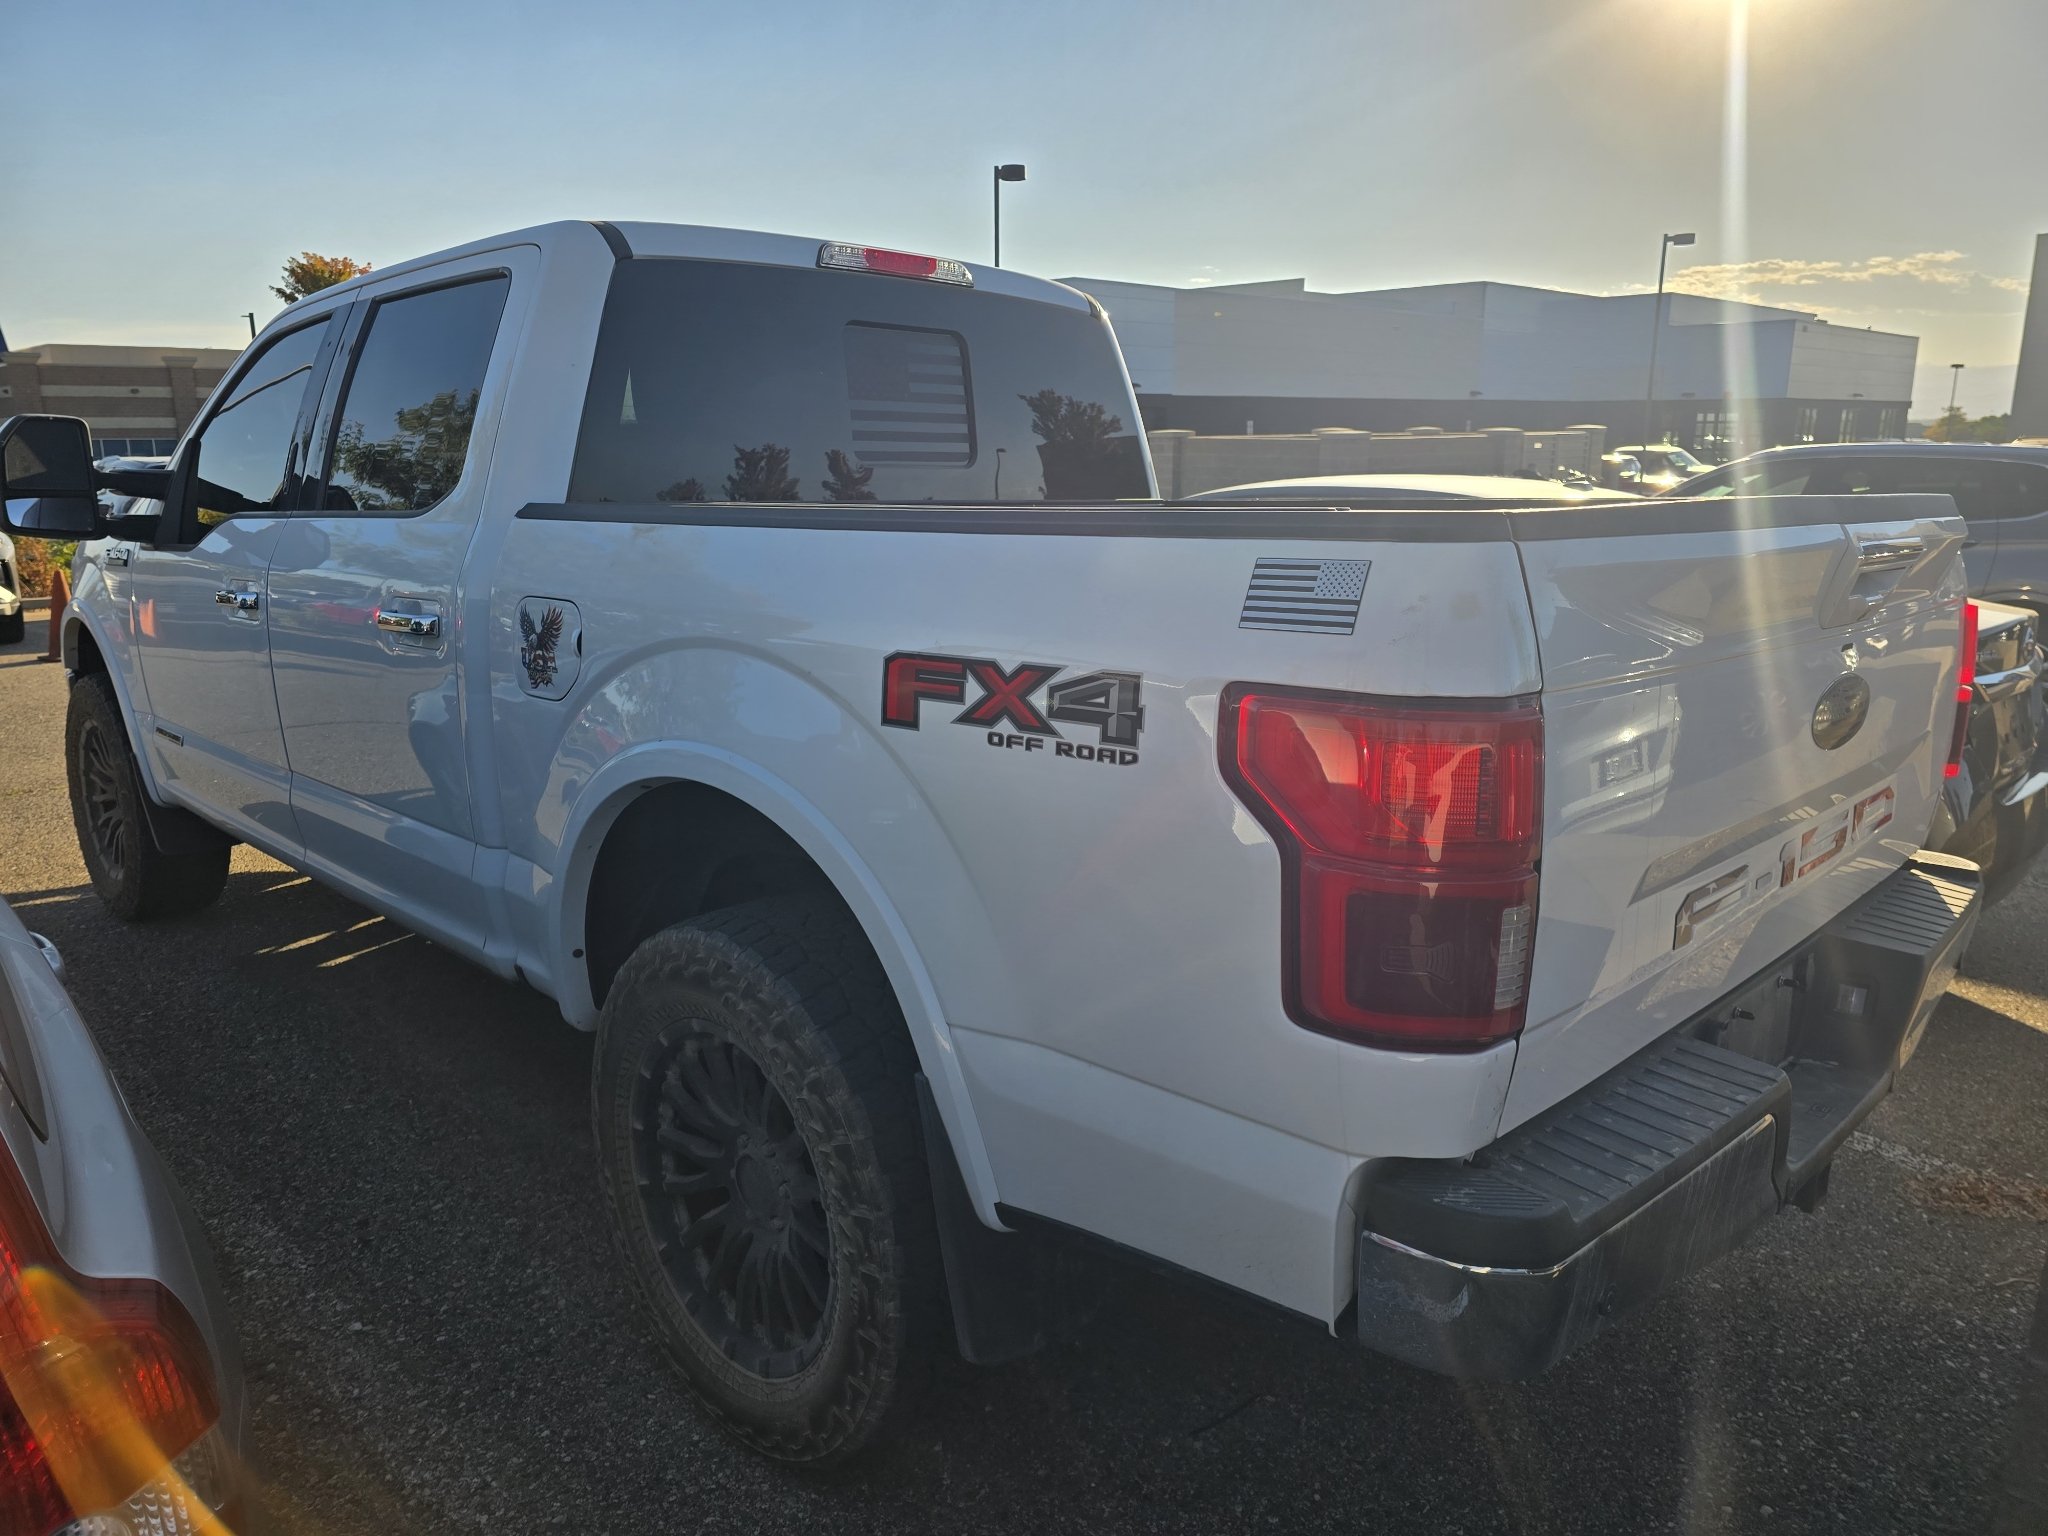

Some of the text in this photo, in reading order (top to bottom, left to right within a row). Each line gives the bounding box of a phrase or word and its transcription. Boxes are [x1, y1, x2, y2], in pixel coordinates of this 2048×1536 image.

[881, 649, 1146, 750] FX4
[987, 731, 1139, 766] OFF ROAD
